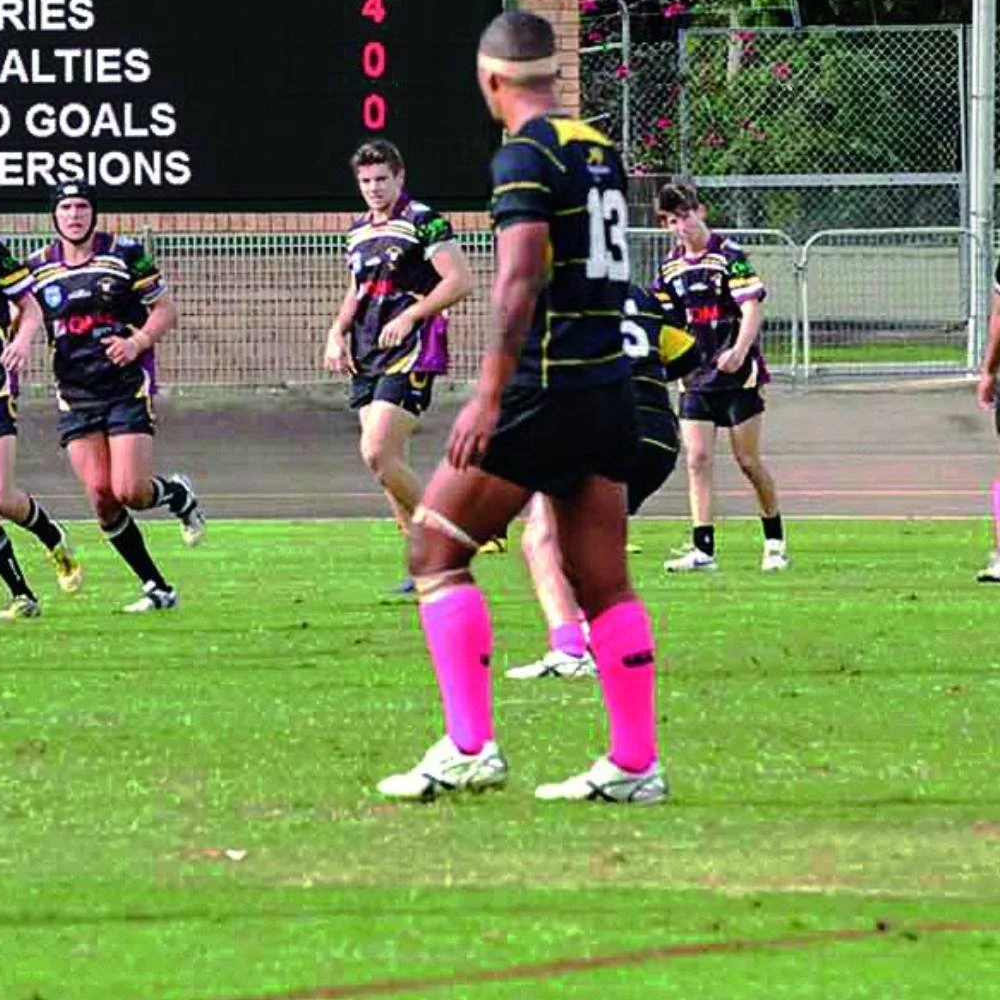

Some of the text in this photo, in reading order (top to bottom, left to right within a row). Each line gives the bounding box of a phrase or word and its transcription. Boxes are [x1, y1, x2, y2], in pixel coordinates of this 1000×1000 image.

[362, 41, 386, 78] 0
[25, 102, 177, 138] GOALS
[363, 93, 387, 130] 0
[585, 186, 630, 281] 13
